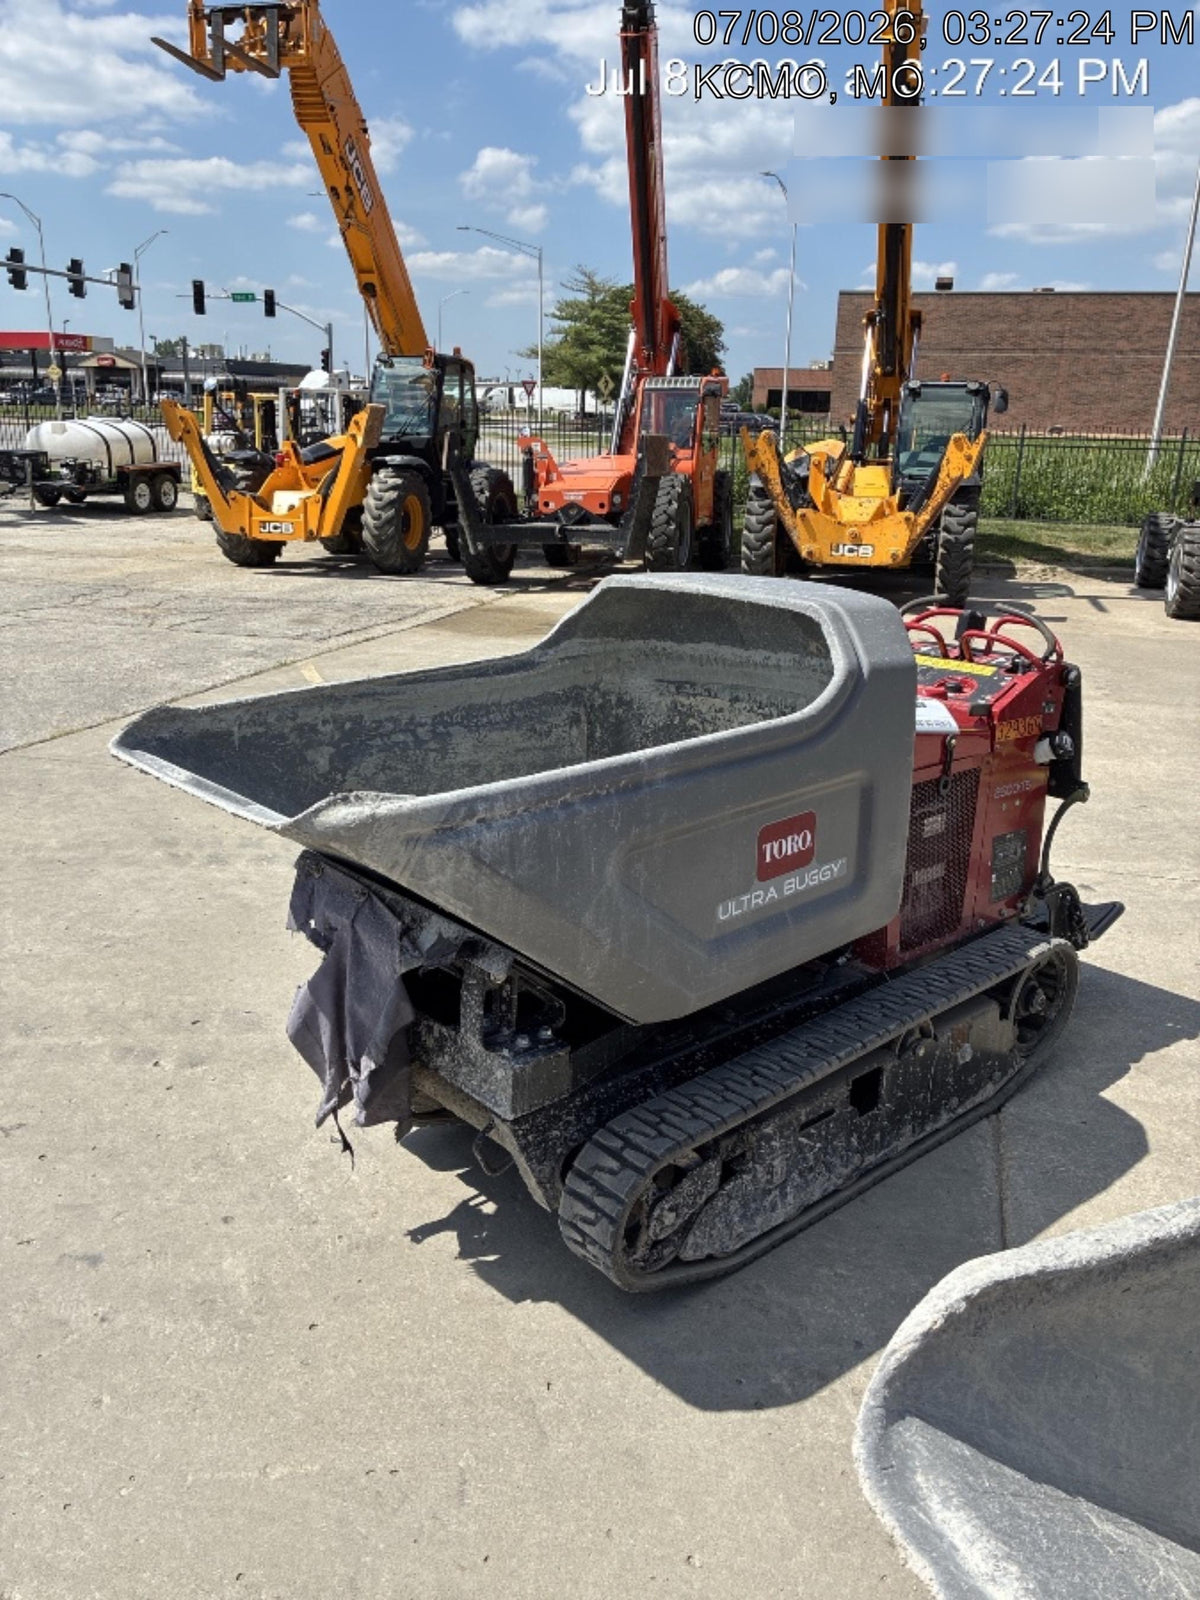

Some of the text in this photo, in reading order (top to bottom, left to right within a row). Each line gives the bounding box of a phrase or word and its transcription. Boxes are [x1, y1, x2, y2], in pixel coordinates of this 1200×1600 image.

[345, 141, 372, 213] JCB
[259, 521, 294, 534] JCB
[831, 544, 873, 557] JCB
[762, 829, 812, 863] TORO
[718, 861, 842, 920] ULTRA BUGGY
